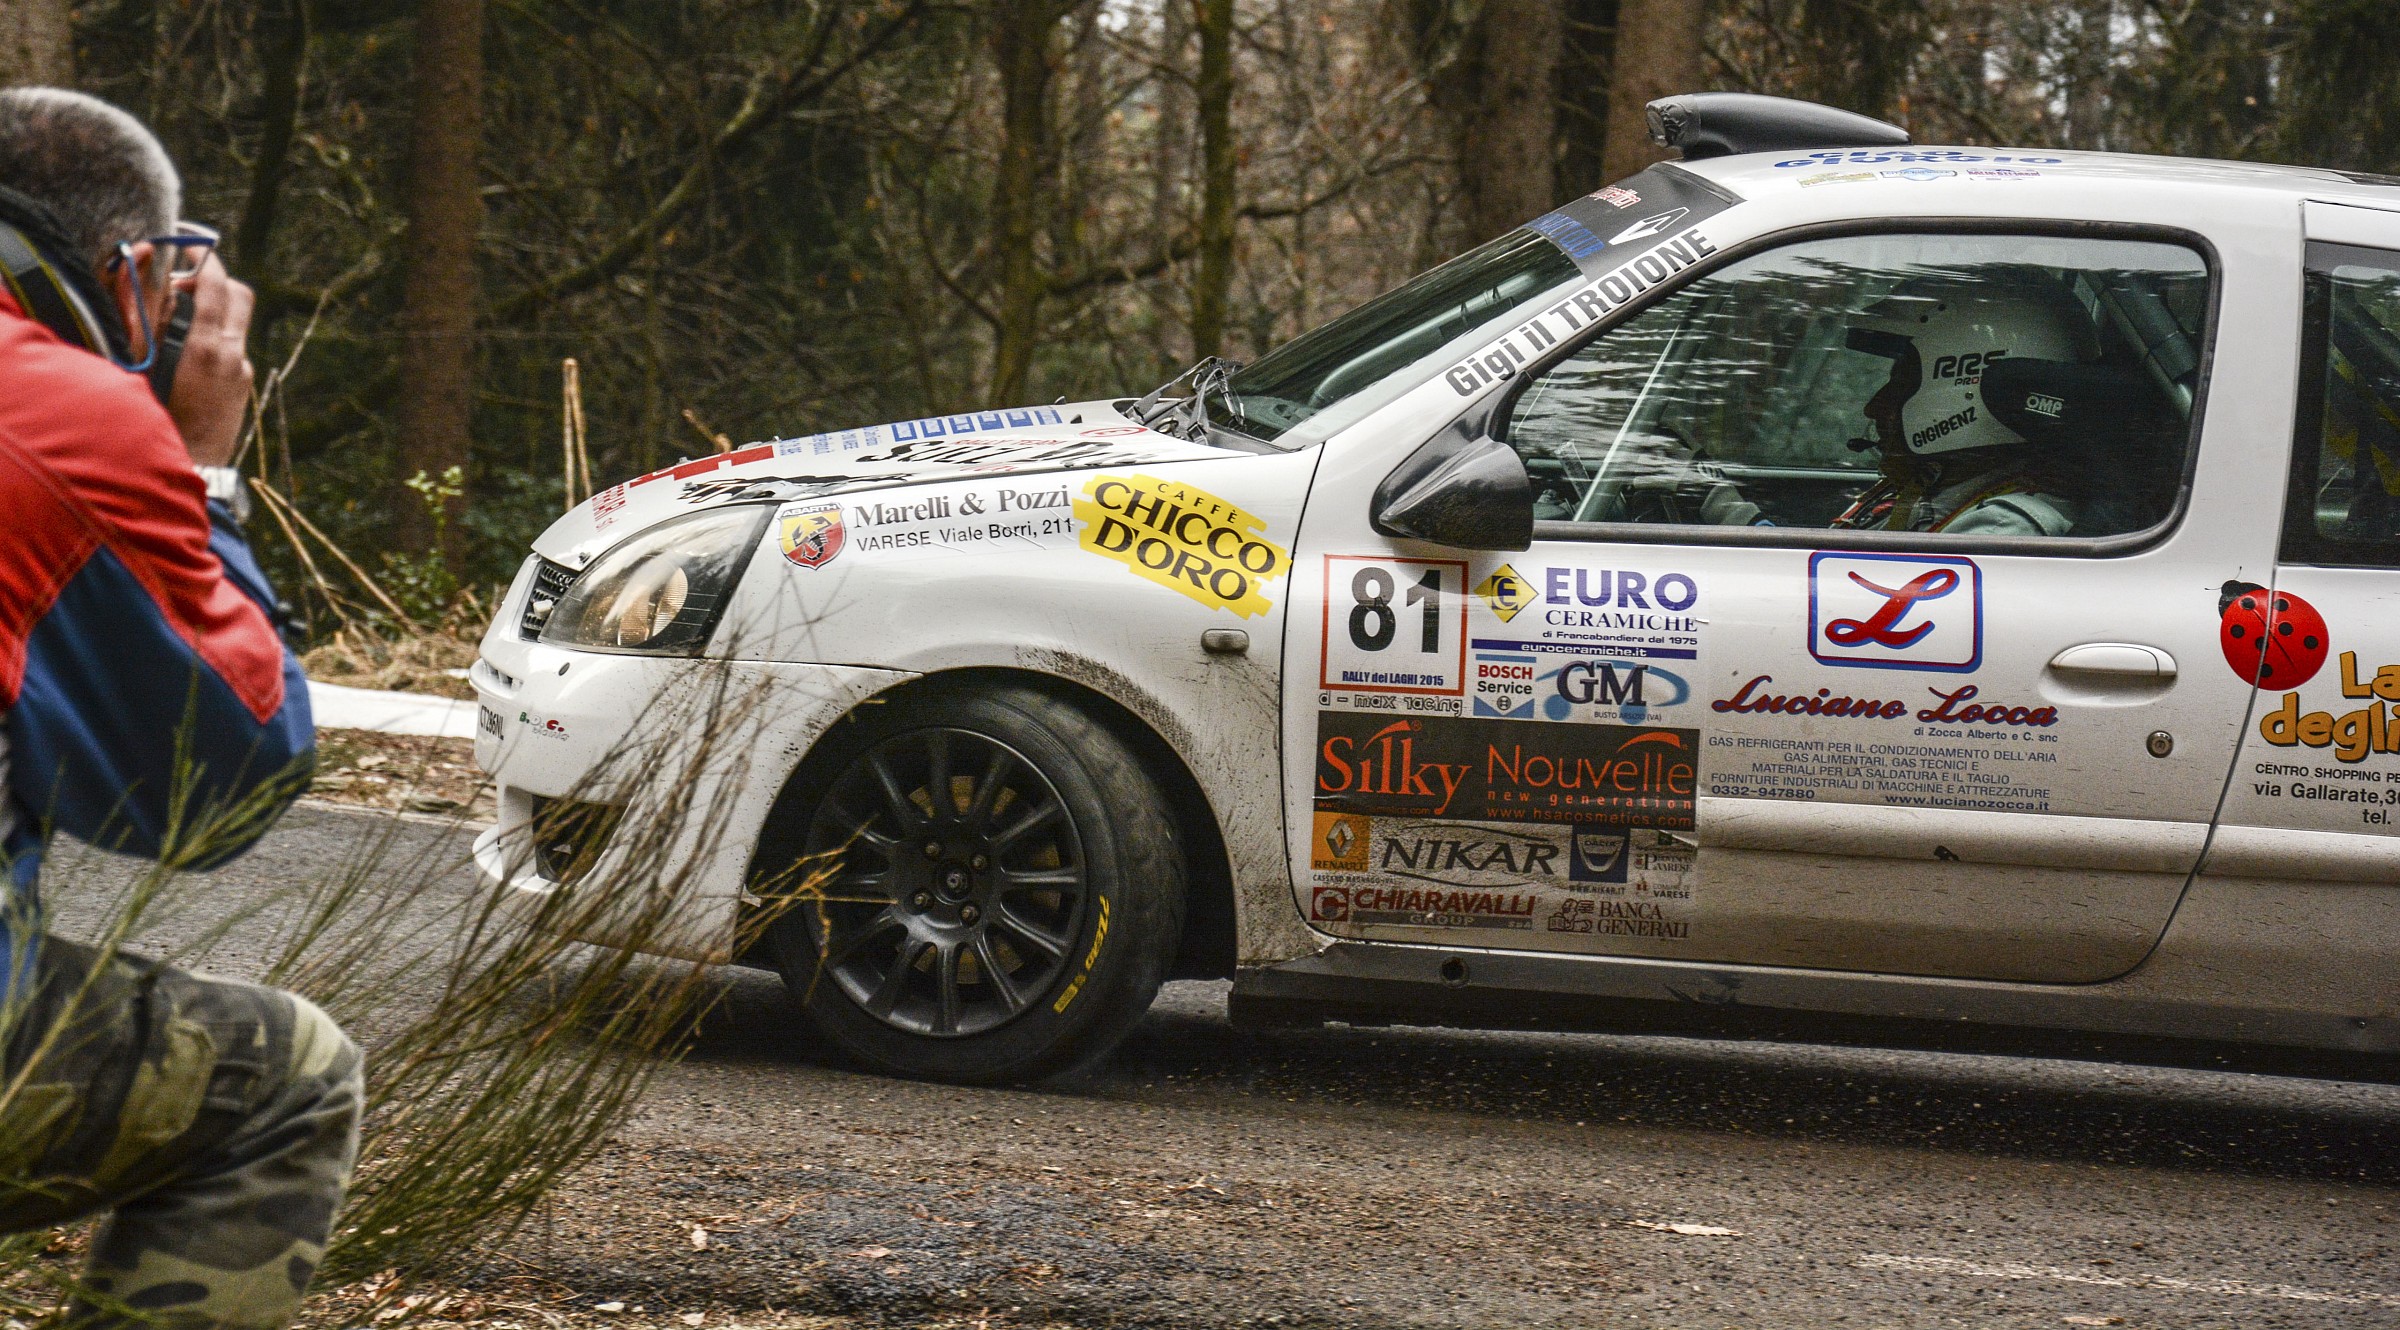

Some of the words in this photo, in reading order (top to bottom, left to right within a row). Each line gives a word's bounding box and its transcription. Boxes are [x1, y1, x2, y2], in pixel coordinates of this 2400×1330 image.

[1774, 155, 2063, 168] GIORGIO
[1445, 338, 1527, 397] Gigi
[1519, 319, 1557, 352] il
[1548, 229, 1718, 331] TROIONE
[2026, 395, 2063, 414] OMP
[783, 505, 837, 517] ABARTH
[854, 496, 950, 528] Marelli
[959, 493, 986, 515] &
[996, 485, 1071, 512] Pozzi
[856, 531, 931, 551] VARESE
[940, 526, 983, 543] Viale
[988, 521, 1038, 540] Borri,
[1042, 518, 1073, 535] 211
[1094, 481, 1276, 574] CHICCO
[1093, 515, 1248, 601] D'ORO
[1546, 567, 1698, 611] EURO
[1349, 566, 1441, 653] 81
[1545, 609, 1698, 632] CERAMICHE
[1542, 631, 1553, 639] di
[1556, 631, 1645, 643] Francabandiera
[1648, 636, 1665, 644] dal
[1669, 637, 1698, 646] 1975
[1521, 643, 1647, 657] euroceramiche.it
[1342, 671, 1370, 682] RALLY
[1389, 673, 1418, 685] LAGHI
[1420, 675, 1444, 686] 2015
[1478, 665, 1533, 680] BOSCH
[2339, 651, 2400, 702] La
[1477, 681, 1533, 694] Service
[1556, 660, 1649, 706] GM
[1318, 690, 1331, 706] d
[1354, 694, 1397, 710] max
[1404, 696, 1464, 717] racing
[1712, 675, 1907, 720] Luciano
[1594, 711, 1617, 719] BUSTO
[1647, 713, 1662, 722] (VA)
[1914, 727, 1924, 736] di
[1928, 728, 1962, 738] Zocca
[1967, 729, 2007, 740] Alberto
[2011, 733, 2018, 741] e
[2023, 732, 2034, 741] C.
[2260, 692, 2400, 763] degli
[1709, 736, 1733, 747] GAS
[1737, 738, 1824, 751] REFRIGERANTI
[1828, 742, 1851, 753] PER
[1855, 744, 1866, 753] IL
[1870, 745, 1990, 759] CONDIZIONAMENTO
[1994, 751, 2057, 762] DELL'ARIA
[1487, 742, 1694, 796] Nouvelle
[1784, 752, 1809, 763] GAS
[1892, 758, 1917, 768] GAS
[1921, 759, 1968, 770] TECNICI
[1972, 761, 1979, 770] E
[1318, 730, 1473, 816] Silky
[1752, 763, 1816, 775] MATERIALI
[1820, 767, 1843, 777] PER
[1846, 768, 1862, 777] LA
[1866, 769, 1938, 781] SALDATURA
[1942, 772, 1949, 781] E
[1953, 773, 1964, 782] IL
[1967, 774, 2010, 784] TAGLIO
[2255, 763, 2309, 777] CENTRO
[2315, 768, 2381, 782] SHOPPING
[1711, 773, 1779, 785] FORNITURE
[1783, 777, 1858, 789] INDUSTRIALI
[1863, 780, 1874, 789] DI
[1878, 781, 1943, 793] MACCHINE
[1947, 784, 1954, 793] E
[1957, 785, 2050, 798] ATTREZZATURE
[1711, 785, 1815, 799] 0332-947880
[2254, 782, 2281, 796] via
[1487, 790, 1531, 802] new
[1549, 793, 1693, 810] generation
[1885, 795, 2050, 811] www.lucianozocca.it
[2362, 809, 2392, 825] tel.
[1314, 861, 1367, 870] RENAULT
[1381, 838, 1560, 875] NIKAR
[1354, 888, 1536, 915] CHIARAVALLI
[1653, 890, 1691, 899] VARESE
[1600, 900, 1663, 920] BANCA
[1410, 915, 1474, 926] GROUP
[1597, 918, 1690, 938] GENERALI
